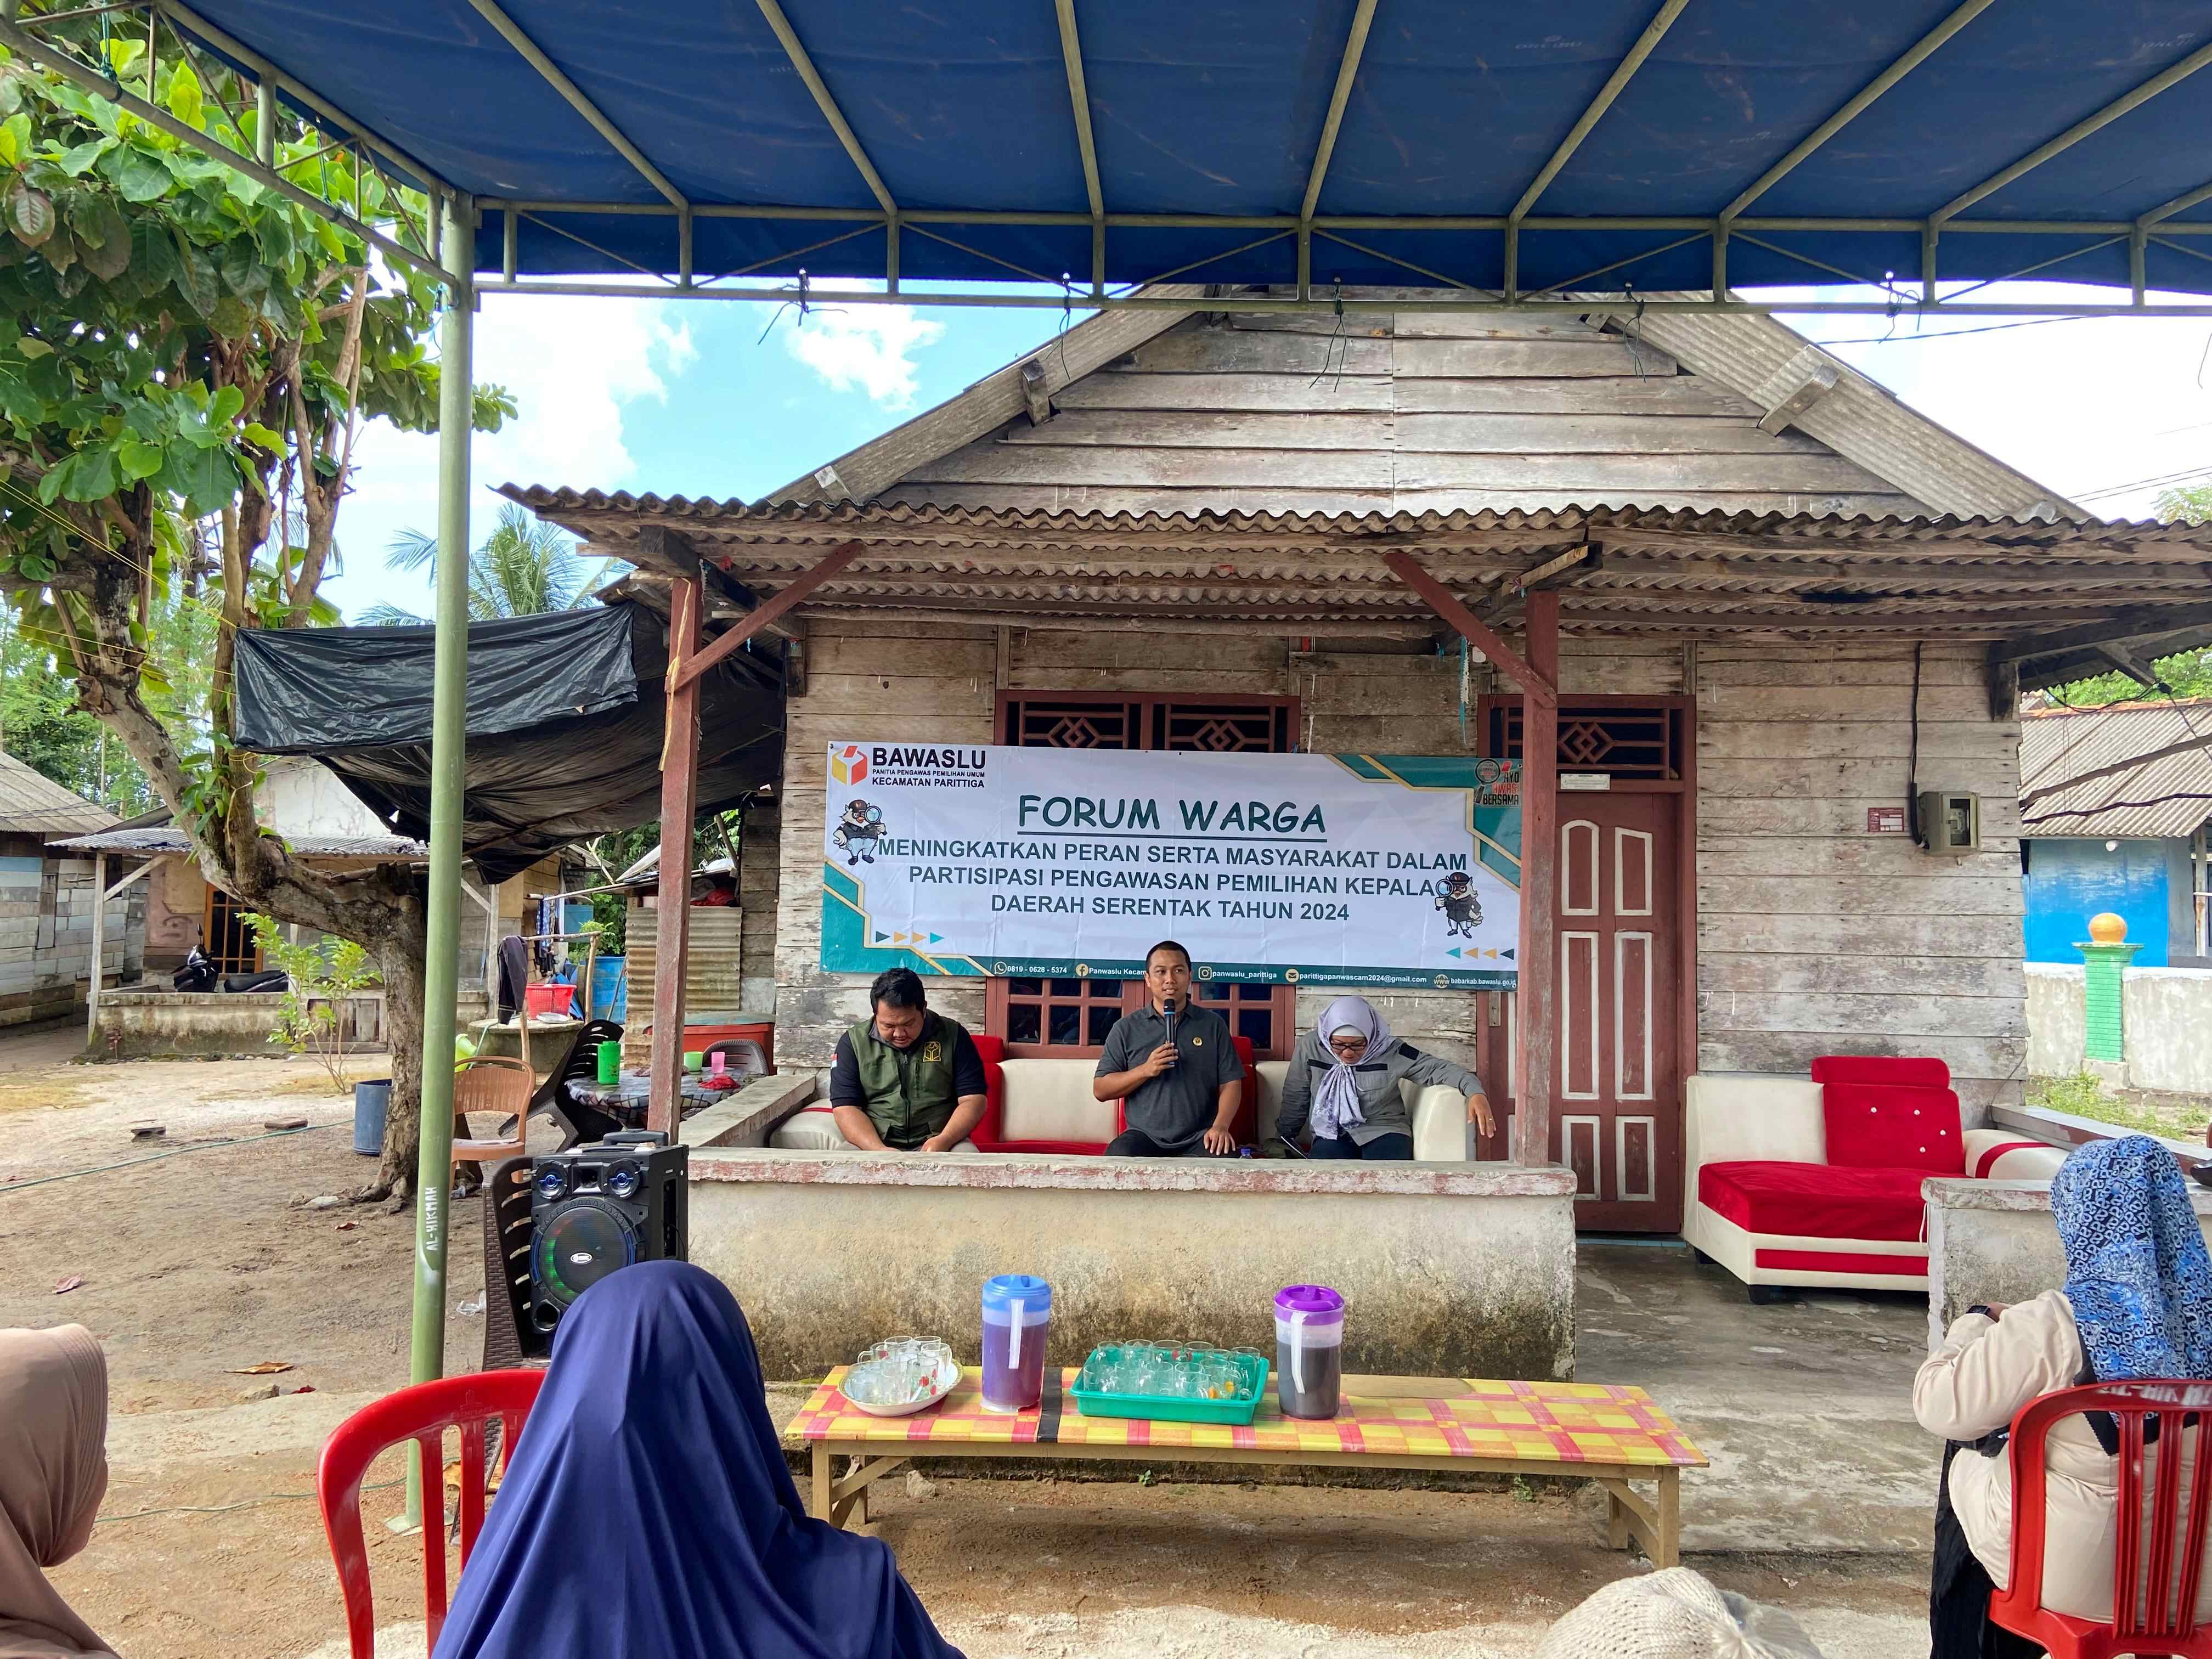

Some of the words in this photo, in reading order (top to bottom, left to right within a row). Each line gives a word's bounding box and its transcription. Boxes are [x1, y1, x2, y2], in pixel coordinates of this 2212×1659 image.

[872, 747, 986, 769] BAWASLU
[872, 777, 931, 787] KECAMATAN
[934, 778, 985, 788] PARITTIGA
[1483, 794, 1519, 805] BERSAMA
[1019, 794, 1160, 831] FORUM
[1178, 799, 1326, 833] WARGA
[878, 838, 1056, 860] MENINGKATKAN
[1064, 843, 1139, 862] PERAN
[1147, 845, 1220, 864] SERTA
[1226, 848, 1380, 868] MASYARAKAT
[1387, 851, 1466, 871] DALAM
[910, 866, 1043, 886] PARTISIPASI
[1051, 869, 1209, 890] PENGAWASAN
[1217, 873, 1337, 894] PEMILIHAN
[1345, 877, 1435, 896] KEPALA
[991, 895, 1084, 913] DAERAH
[1092, 897, 1211, 917] SERENTAK
[1218, 900, 1293, 919] TAHUN
[1300, 902, 1350, 921] 2024
[1212, 970, 1277, 979] panwaslu_parittiga
[1299, 973, 1427, 983] parittigapanwascam2024@gmail.com
[425, 1187, 439, 1251] AL-HIKMAH
